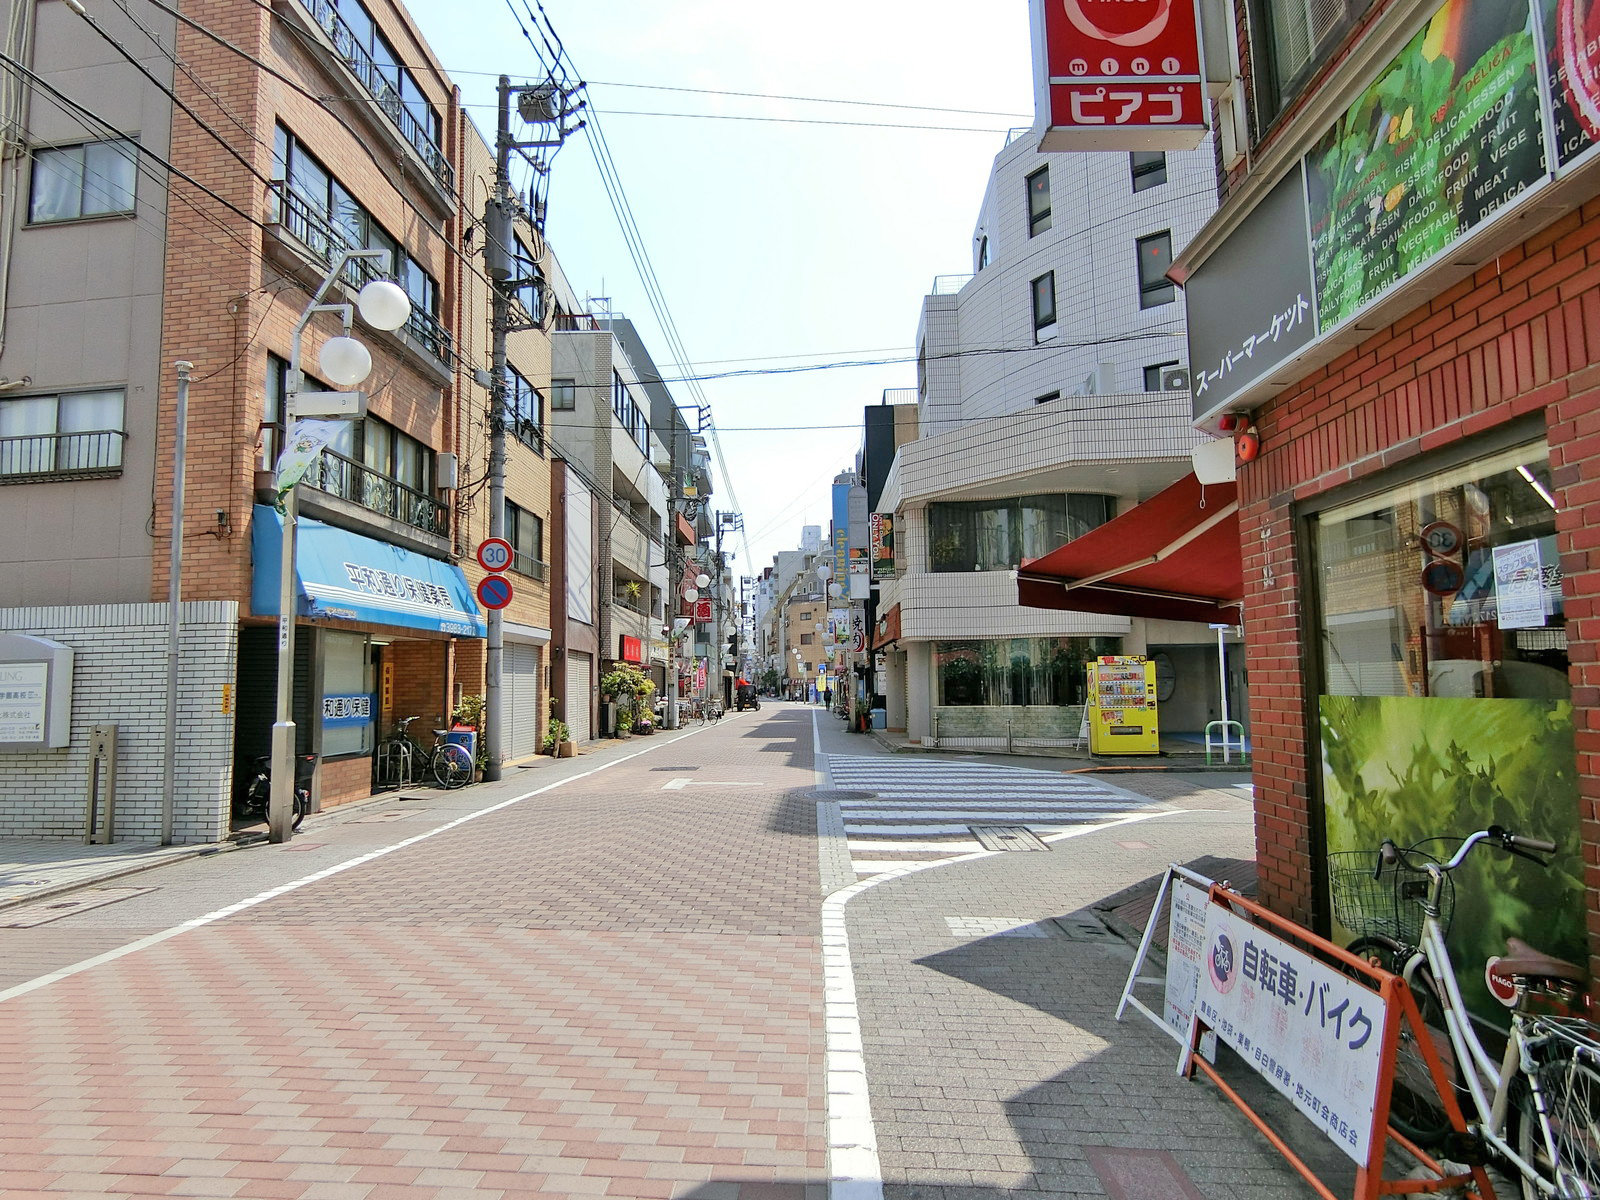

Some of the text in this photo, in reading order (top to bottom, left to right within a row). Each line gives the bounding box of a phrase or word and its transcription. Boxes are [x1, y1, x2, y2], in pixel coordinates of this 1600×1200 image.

[1070, 60, 1177, 73] mini
[1070, 86, 1184, 124] ピアゴ
[1465, 45, 1511, 93] DELICA
[1340, 224, 1358, 246] FISH
[1444, 86, 1514, 157] DAILYFOOD
[1395, 152, 1417, 178] FISH
[1426, 64, 1515, 150] DELICATESSEN
[1316, 266, 1332, 285] FISH
[1338, 209, 1400, 266] DELICATESSEN
[1408, 151, 1469, 208] DAILYFOOD
[1480, 111, 1518, 149] FRUIT
[1318, 250, 1374, 301] DELICATESSEN
[1381, 201, 1437, 250] DAILYFOOD
[1446, 165, 1480, 200] FRUIT
[1490, 128, 1527, 163] VEGE
[1319, 280, 1362, 318] DAILYFOOD
[1368, 254, 1394, 280] FRUIT
[1402, 201, 1464, 254] VEGETABLE
[1474, 166, 1509, 200] MEAT
[1320, 181, 1527, 334] FRUIT VEGETABLE MEAT FISH DELICA
[1196, 293, 1309, 397] スーパーマーケット
[345, 562, 455, 608] 平和通り保健薬局
[485, 547, 506, 563] 30
[697, 602, 711, 617] 酒
[324, 697, 370, 718] 和通り保健
[1242, 940, 1372, 1050] 自転車・バイク
